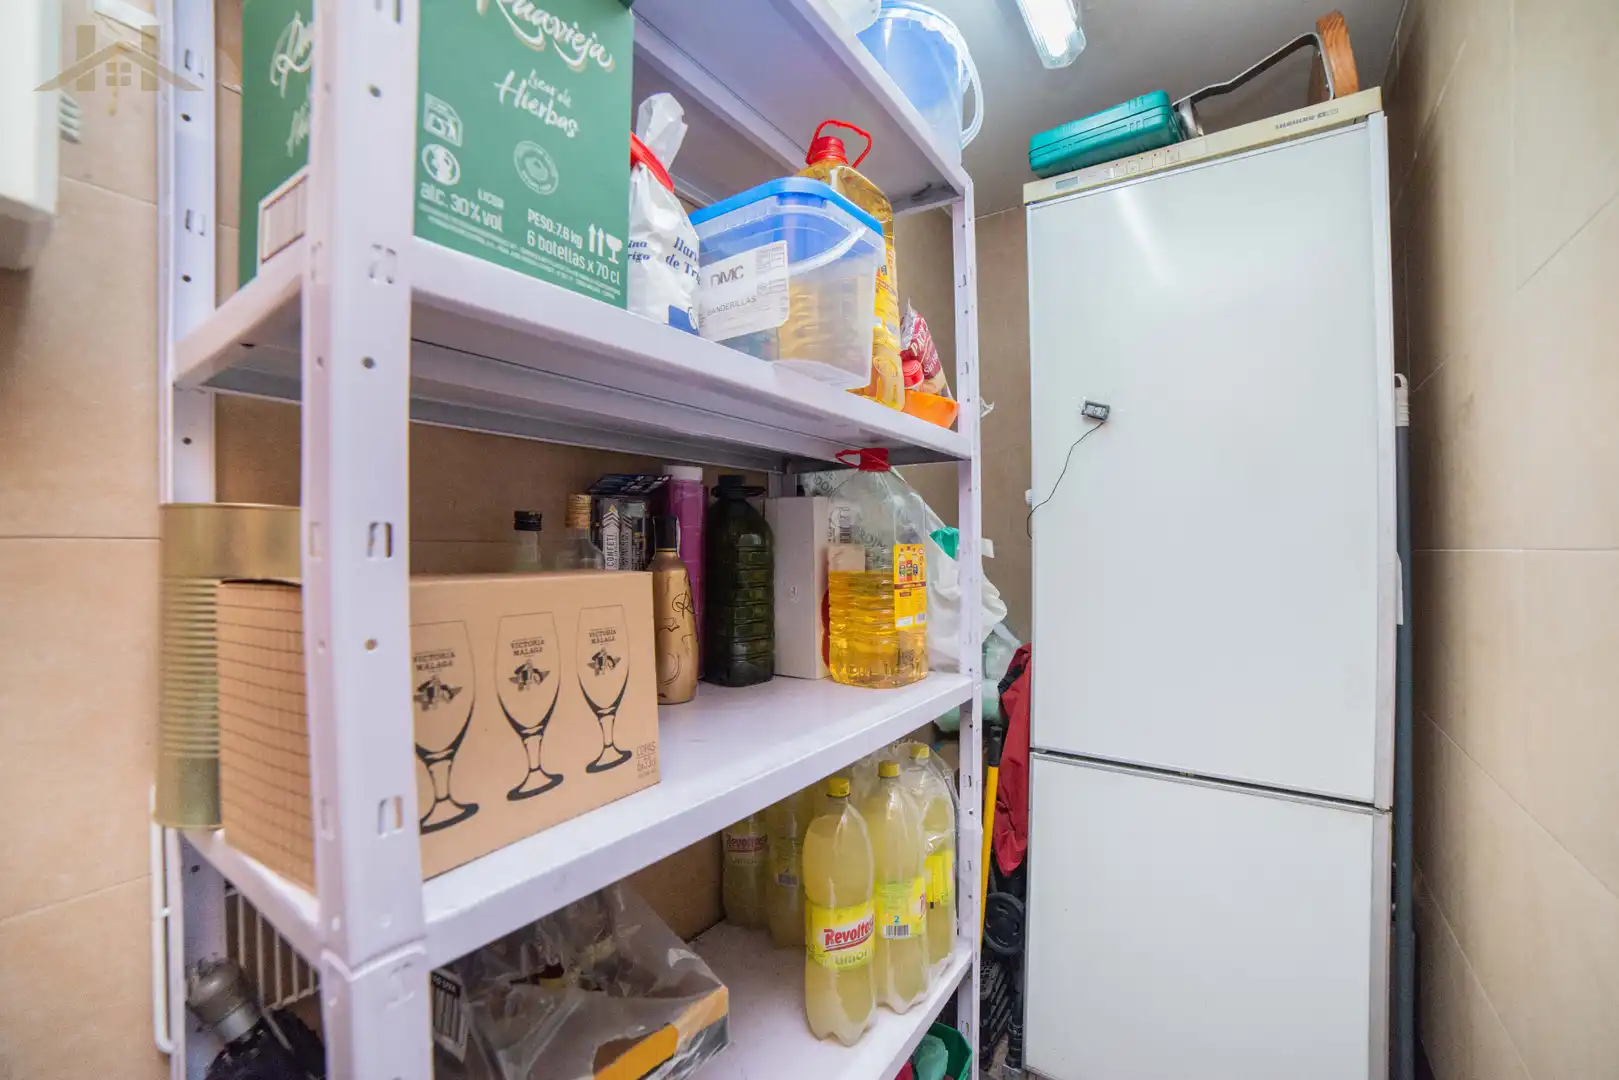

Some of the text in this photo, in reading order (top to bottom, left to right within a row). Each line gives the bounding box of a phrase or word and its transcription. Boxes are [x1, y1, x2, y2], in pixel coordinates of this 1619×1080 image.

[494, 70, 579, 138] Hierbas
[628, 240, 648, 248] ina
[526, 230, 536, 247] 6
[538, 233, 586, 268] botellas
[596, 261, 610, 280] 70
[628, 252, 651, 263] rigo
[666, 254, 680, 270] de
